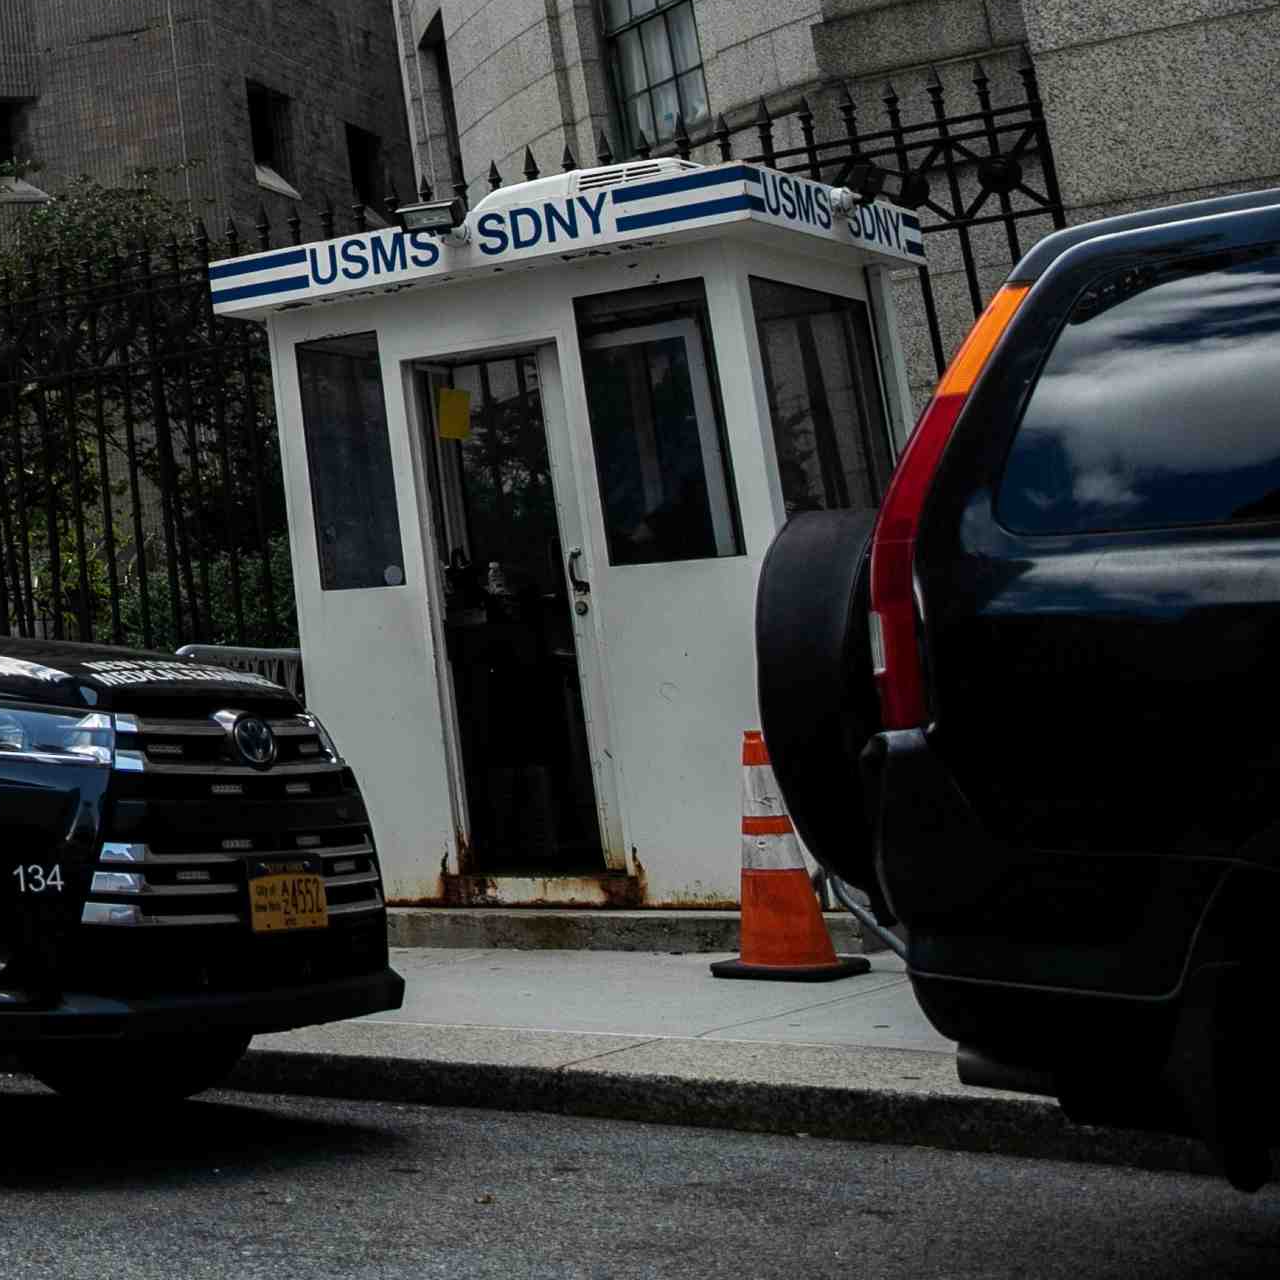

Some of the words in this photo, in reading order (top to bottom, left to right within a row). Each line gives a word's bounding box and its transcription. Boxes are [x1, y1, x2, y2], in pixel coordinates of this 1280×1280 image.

[761, 172, 832, 230] USMS
[309, 231, 440, 286] USMS
[477, 192, 608, 256] SDNY
[13, 864, 64, 892] 134
